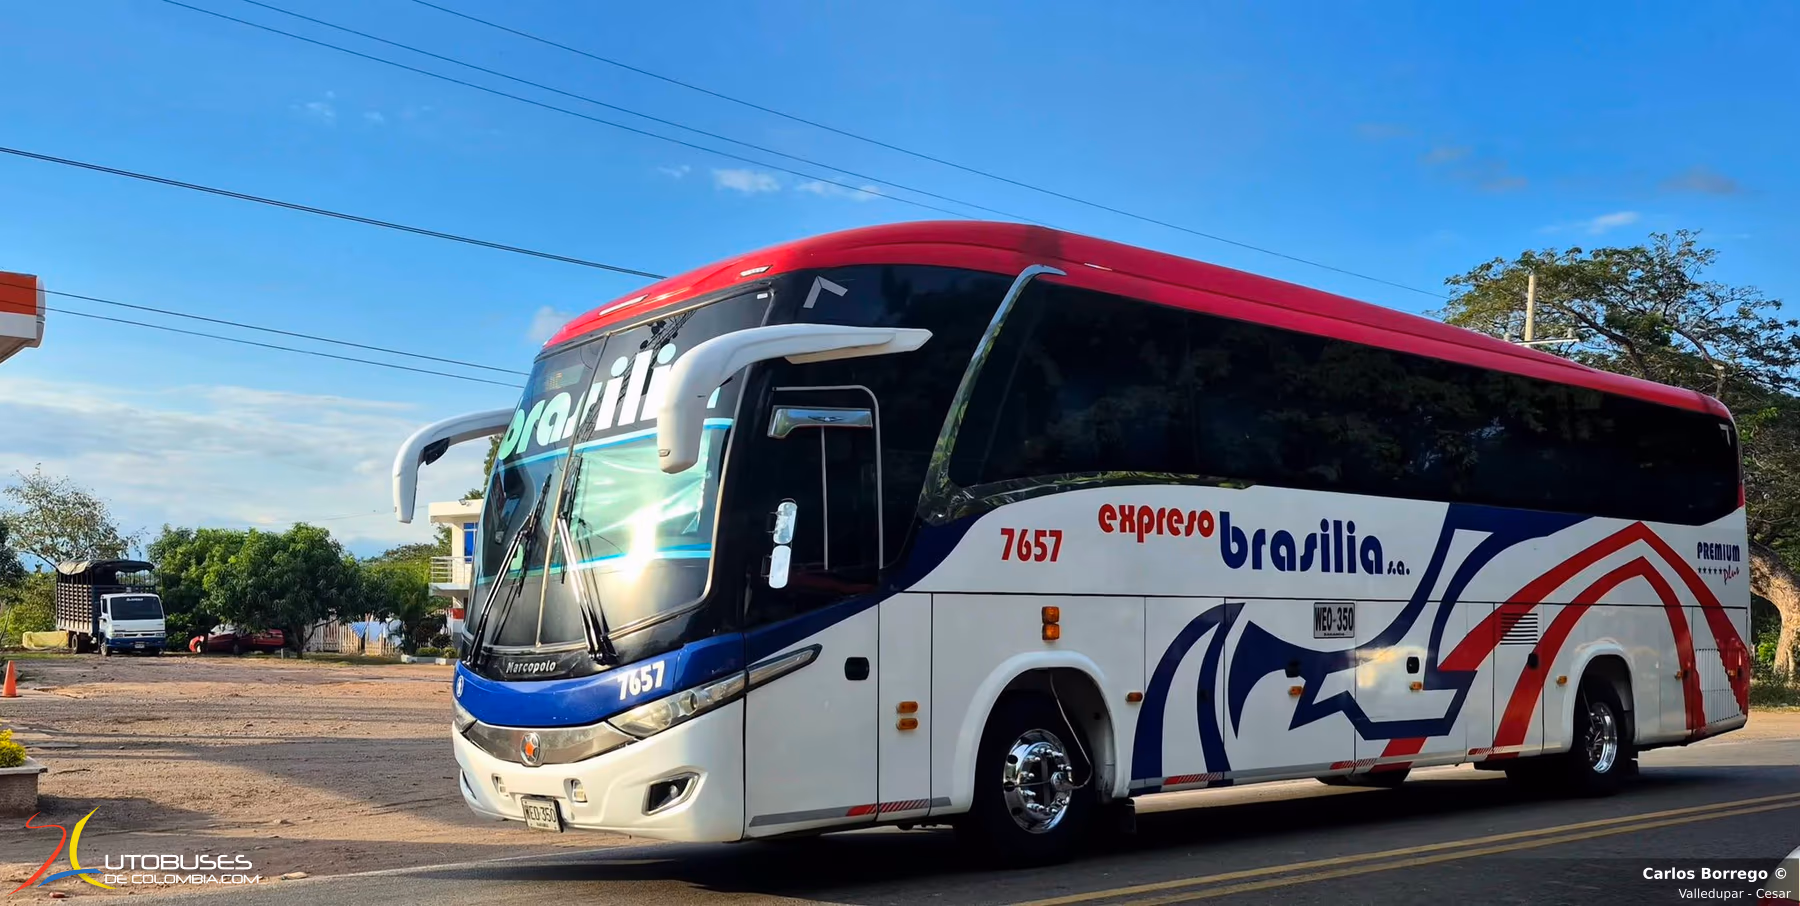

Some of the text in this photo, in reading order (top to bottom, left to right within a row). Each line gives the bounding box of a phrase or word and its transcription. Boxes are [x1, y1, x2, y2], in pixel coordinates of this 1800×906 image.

[498, 343, 721, 460] brasili
[1000, 527, 1063, 563] 7657
[1098, 503, 1215, 543] expreso
[1219, 511, 1384, 575] brasilia
[1697, 541, 1741, 562] PREMIUM
[1314, 606, 1354, 632] WEO-350
[506, 660, 556, 673] Marcopolo
[617, 661, 665, 700] 7657
